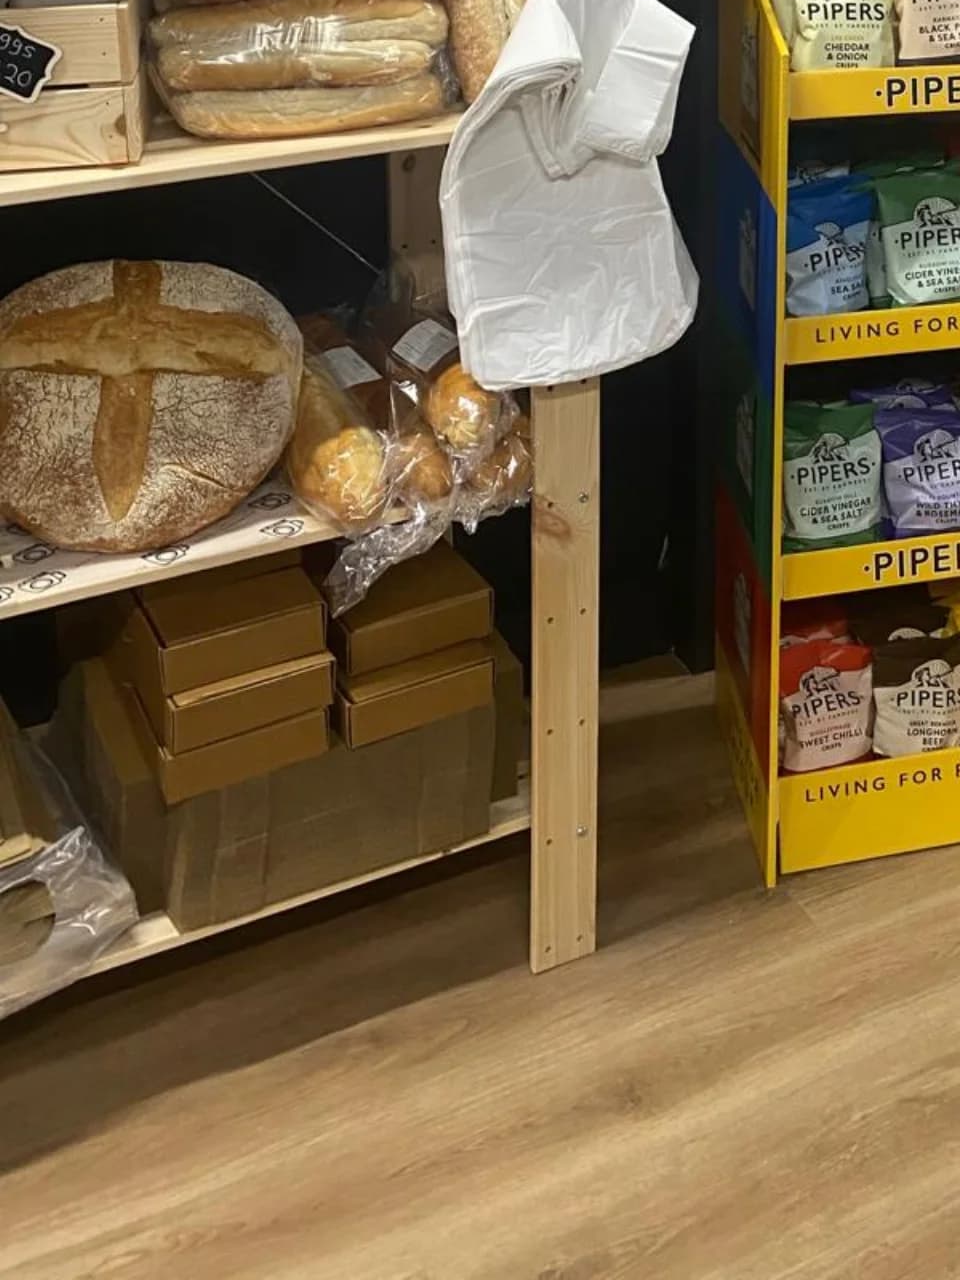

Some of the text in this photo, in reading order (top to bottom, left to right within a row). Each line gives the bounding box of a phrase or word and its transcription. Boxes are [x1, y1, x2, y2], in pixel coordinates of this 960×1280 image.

[807, 3, 885, 21] PIPERS
[919, 23, 950, 34] BLACK
[937, 33, 955, 42] SEA
[824, 43, 869, 52] CHEDDAR
[836, 52, 868, 61] ONION
[905, 270, 934, 281] CIDER
[926, 278, 944, 287] SEA
[831, 285, 849, 295] SEA
[815, 321, 899, 343] LIVING
[914, 316, 958, 334] FOR
[797, 457, 871, 486] PIPERS
[800, 505, 829, 517] CIDER
[831, 497, 871, 512] VINEGAR
[821, 515, 838, 523] SEA
[841, 509, 863, 520] SALT
[791, 691, 861, 719] PIPERS
[906, 727, 958, 737] LONGHORN
[800, 735, 828, 750] SWEET
[832, 728, 863, 741] CHILLI
[922, 737, 943, 746] BEEF
[805, 777, 886, 803] LIVING
[899, 767, 942, 787] FOR
